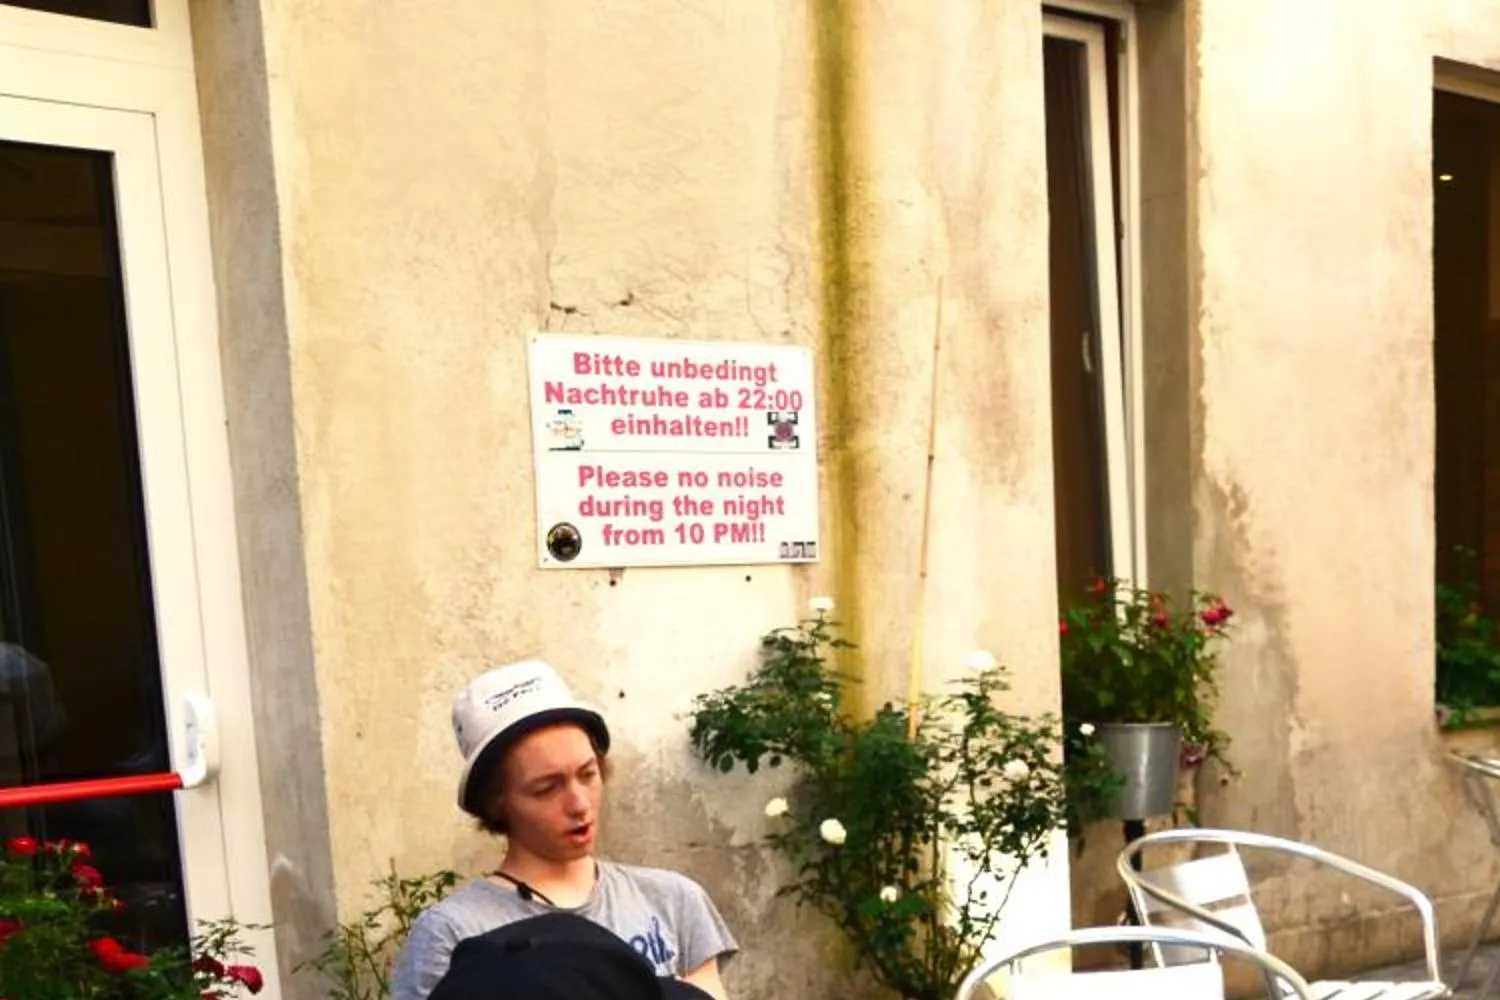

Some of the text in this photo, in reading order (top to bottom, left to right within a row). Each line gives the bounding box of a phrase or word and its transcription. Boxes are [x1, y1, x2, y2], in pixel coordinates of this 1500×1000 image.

[572, 351, 778, 387] Bitte unbedingt
[543, 381, 803, 411] Nachtruhe ab 22:00
[610, 414, 749, 437] einhalten!!
[578, 465, 784, 488] Please no noise
[578, 495, 785, 521] during the night
[602, 522, 766, 545] from 10 PM!!
